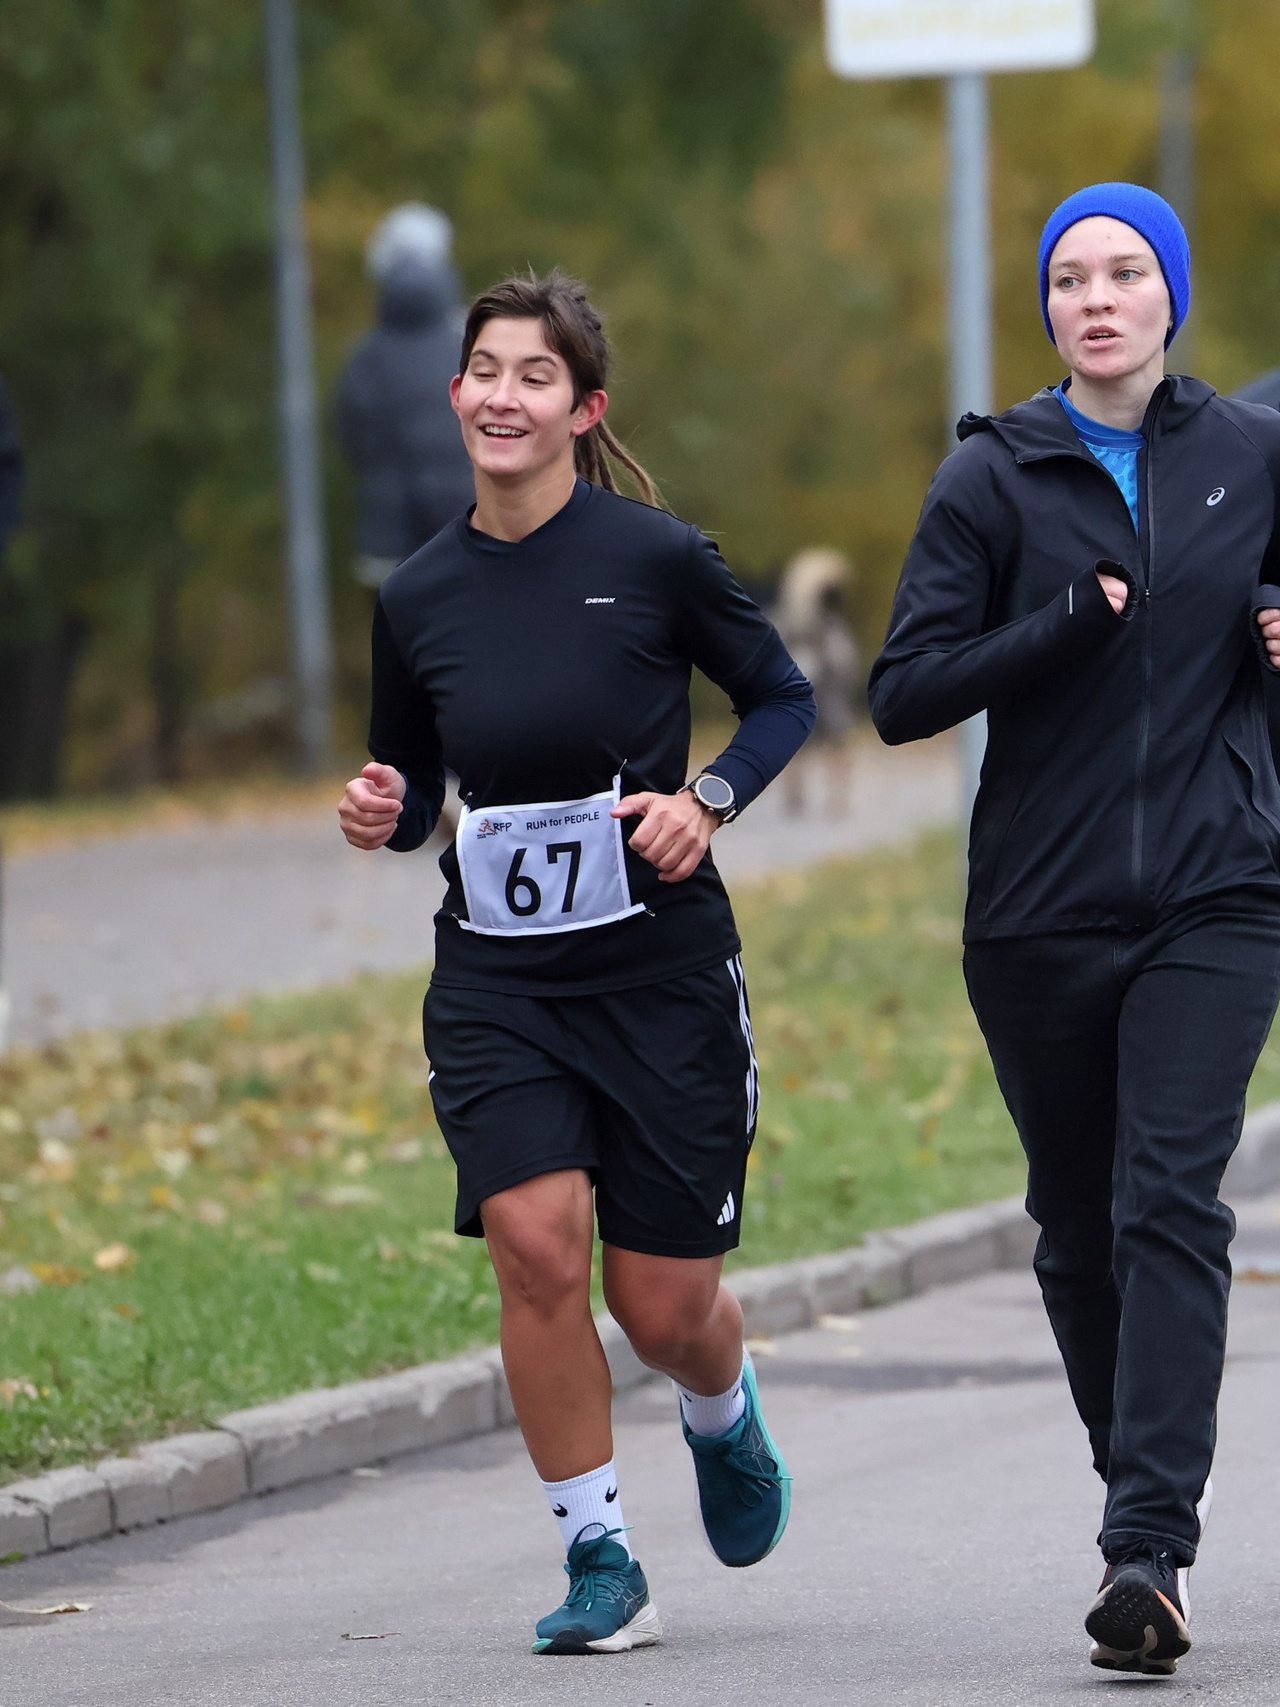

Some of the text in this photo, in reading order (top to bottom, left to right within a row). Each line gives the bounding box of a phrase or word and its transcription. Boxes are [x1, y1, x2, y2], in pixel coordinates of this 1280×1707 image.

[493, 822, 513, 833] RFP
[526, 811, 600, 831] RUN for PEOPLE
[505, 841, 582, 917] 67
